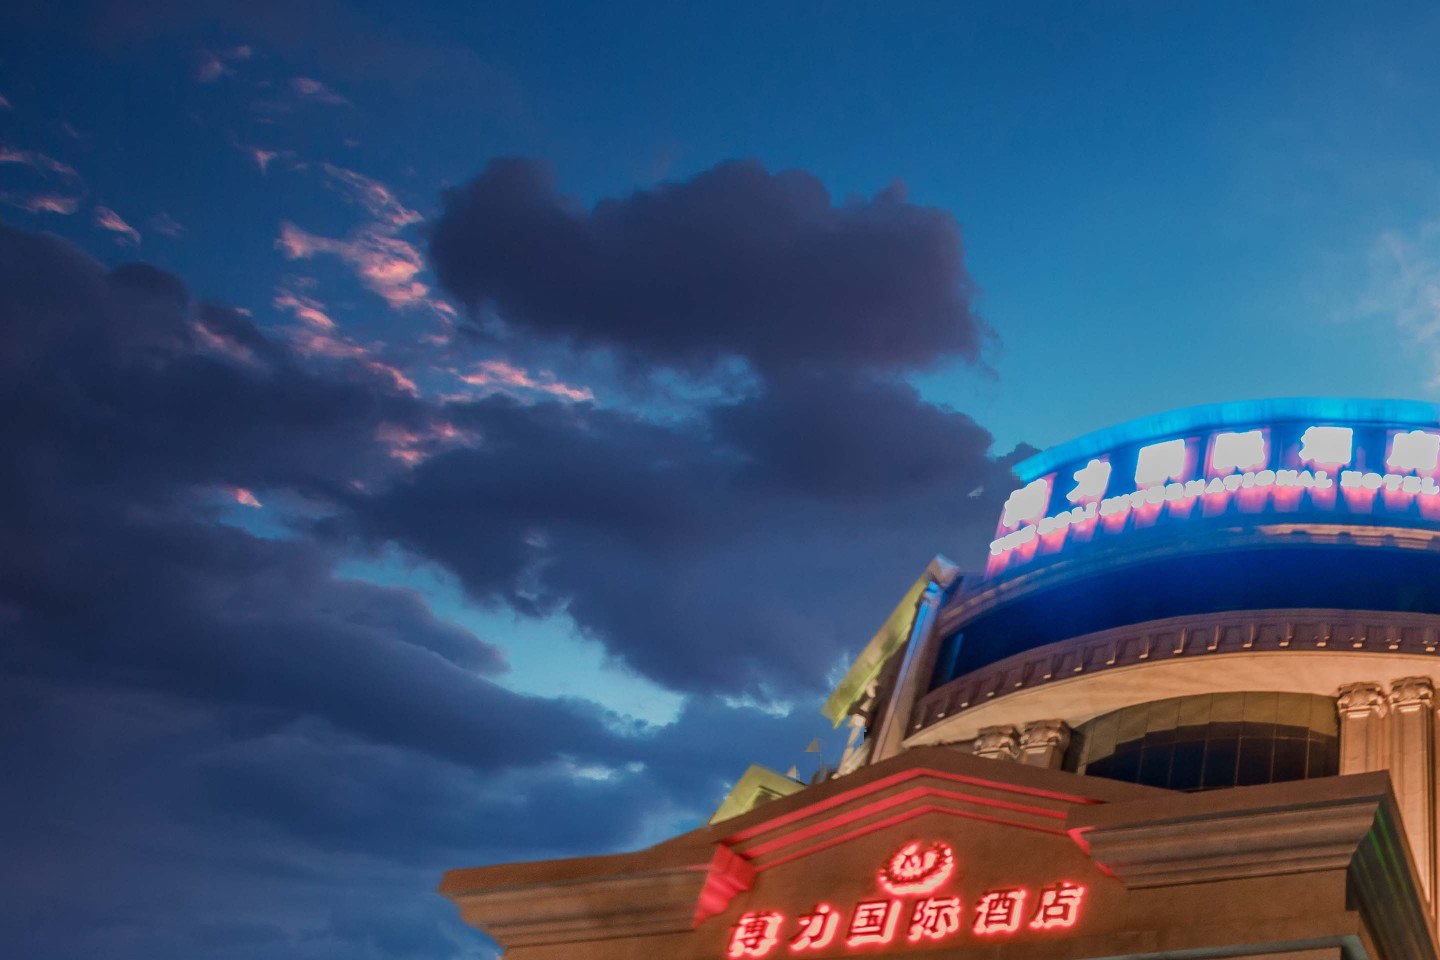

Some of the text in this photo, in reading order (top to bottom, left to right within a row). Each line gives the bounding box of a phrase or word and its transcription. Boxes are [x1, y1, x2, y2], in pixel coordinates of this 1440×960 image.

[1099, 470, 1333, 516] INTERNATIONAL
[1341, 471, 1440, 496] HOTEL
[730, 883, 1084, 957] 博力国际酒店
